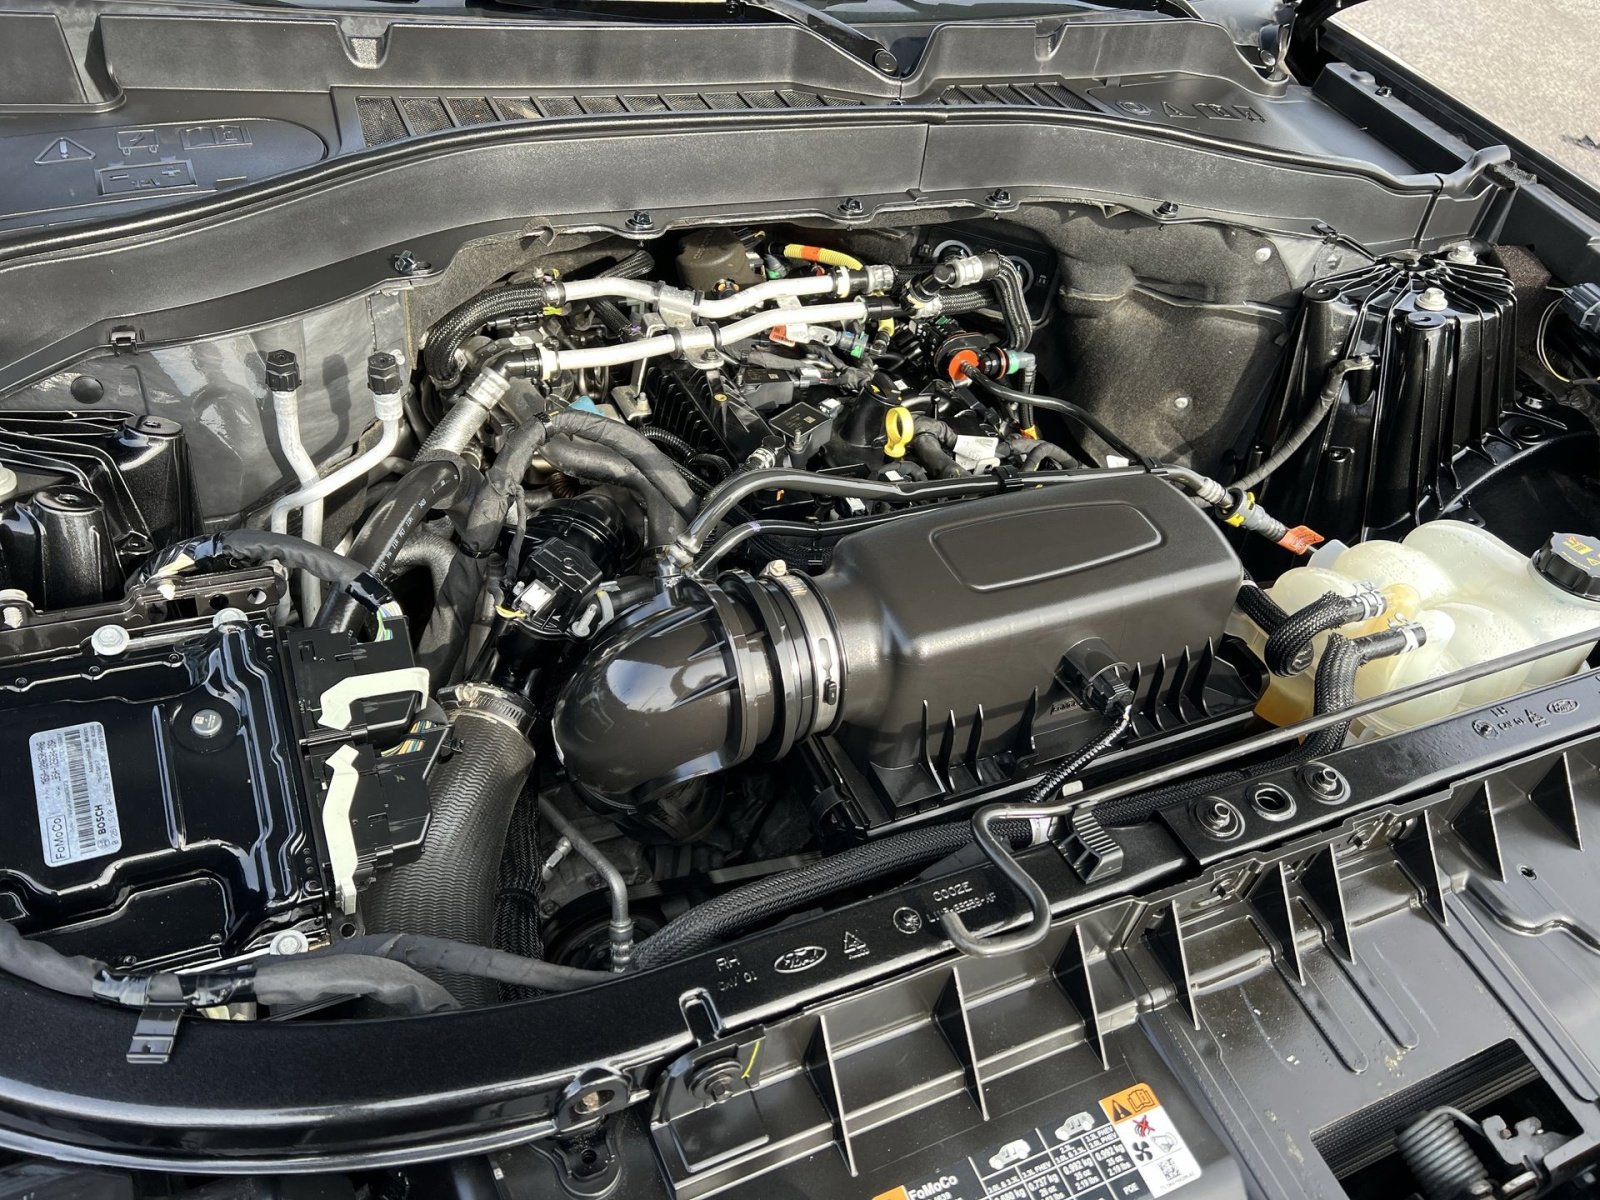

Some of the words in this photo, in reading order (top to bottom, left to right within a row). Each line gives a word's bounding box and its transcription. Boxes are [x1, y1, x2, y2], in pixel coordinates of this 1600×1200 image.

[94, 804, 106, 835] BOSCH
[51, 817, 66, 860] FoMoCo
[1113, 1143, 1125, 1154] kg
[1081, 1157, 1094, 1168] kg
[1106, 1157, 1116, 1167] 35
[1119, 1161, 1132, 1172] lbs
[1047, 1173, 1060, 1184] kg
[1074, 1171, 1083, 1181] 35
[1087, 1175, 1100, 1186] lbs
[908, 1175, 959, 1200] FoMoCo
[1013, 1188, 1027, 1198] kg
